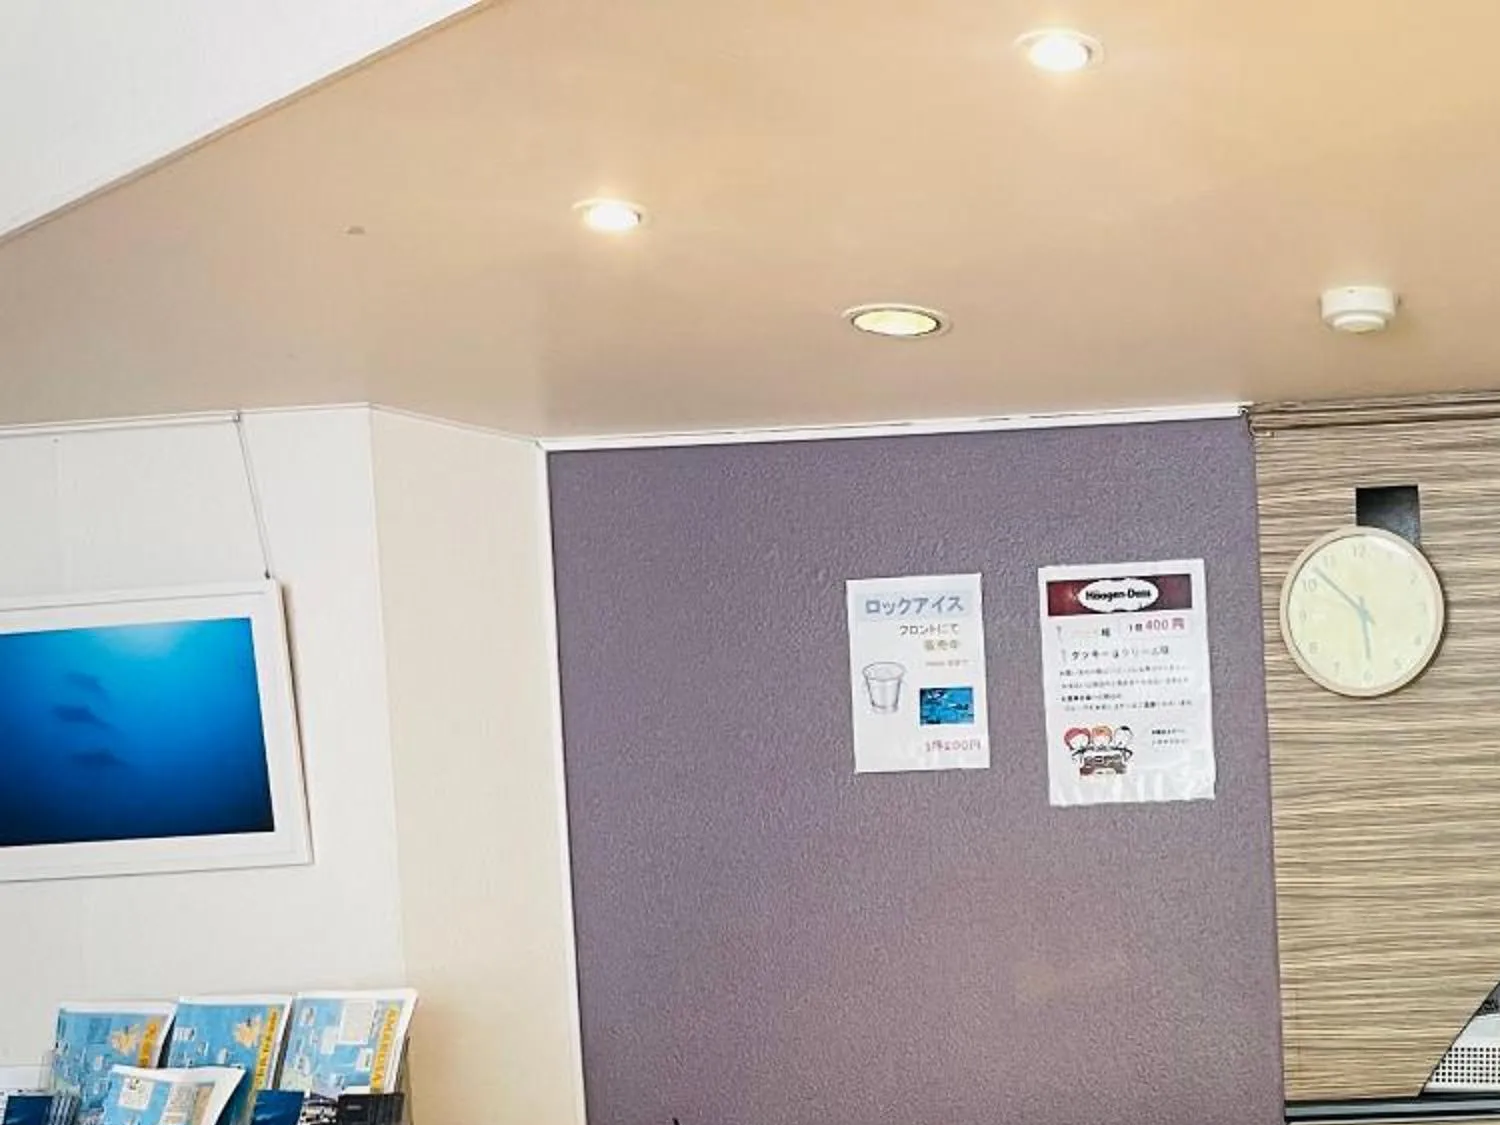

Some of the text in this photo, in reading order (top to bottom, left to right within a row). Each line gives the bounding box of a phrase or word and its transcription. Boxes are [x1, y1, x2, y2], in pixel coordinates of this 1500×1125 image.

[865, 595, 965, 616] ロックアイス
